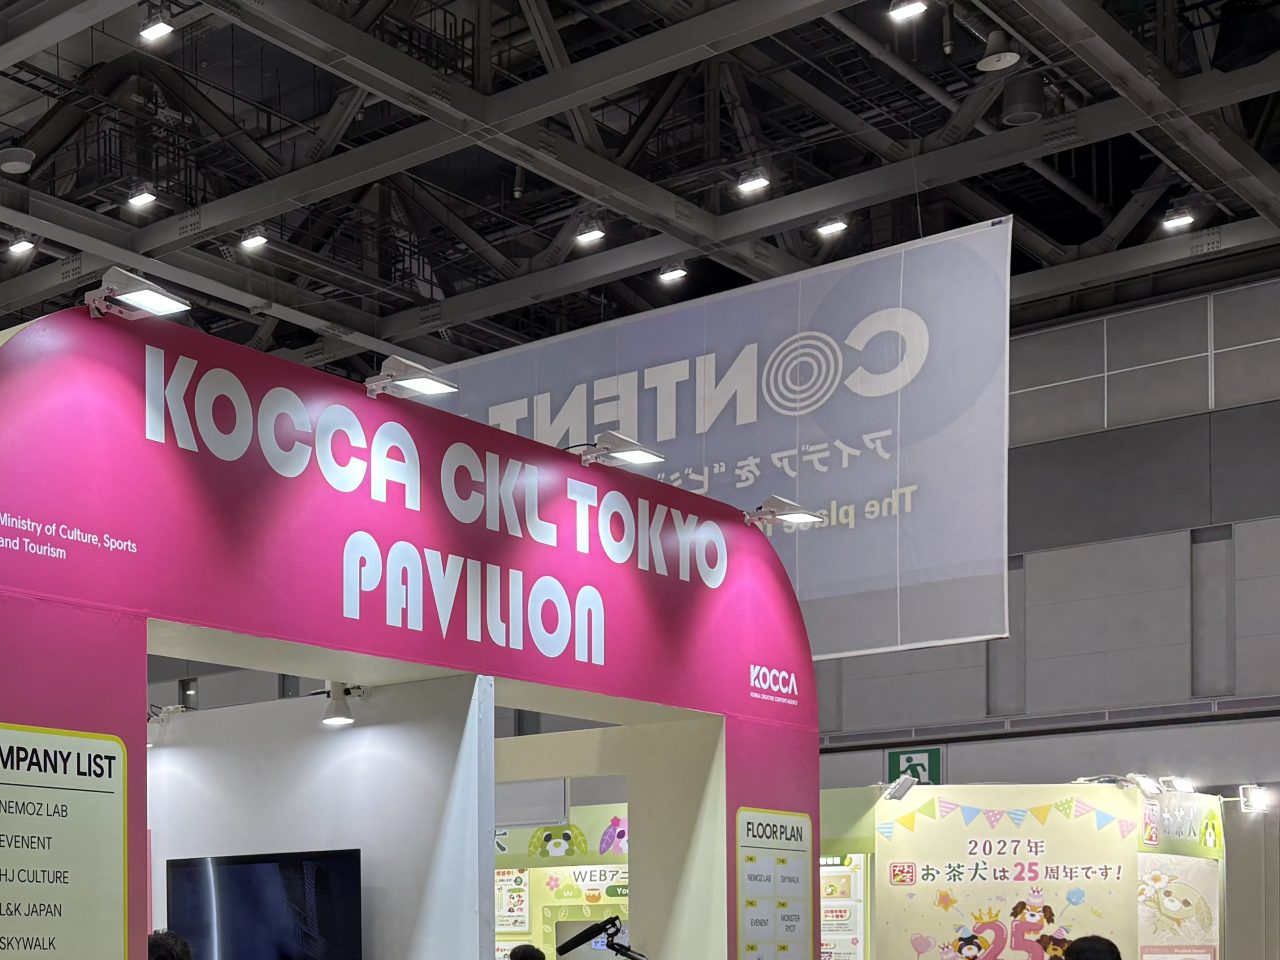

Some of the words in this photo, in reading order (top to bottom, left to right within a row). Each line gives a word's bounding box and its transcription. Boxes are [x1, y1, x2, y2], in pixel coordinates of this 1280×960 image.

[146, 344, 420, 512] KOCCA
[441, 442, 557, 548] CKL
[567, 477, 727, 589] TOKYO
[45, 523, 56, 536] of
[59, 525, 101, 548] Culture,
[103, 534, 137, 553] Sports
[23, 538, 66, 559] Tourism
[343, 531, 604, 666] PAVILION
[750, 664, 798, 695] KOCCA
[76, 752, 116, 779] LIST
[46, 802, 68, 818] LAB
[746, 822, 778, 840] FLOOR
[779, 825, 803, 842] PLAN
[968, 838, 1045, 856] 2027年
[0, 868, 15, 883] HJ
[18, 869, 69, 884] CULTURE
[0, 903, 21, 917] L&K
[24, 904, 62, 917] JAPAN
[0, 936, 56, 950] SKYWALK
